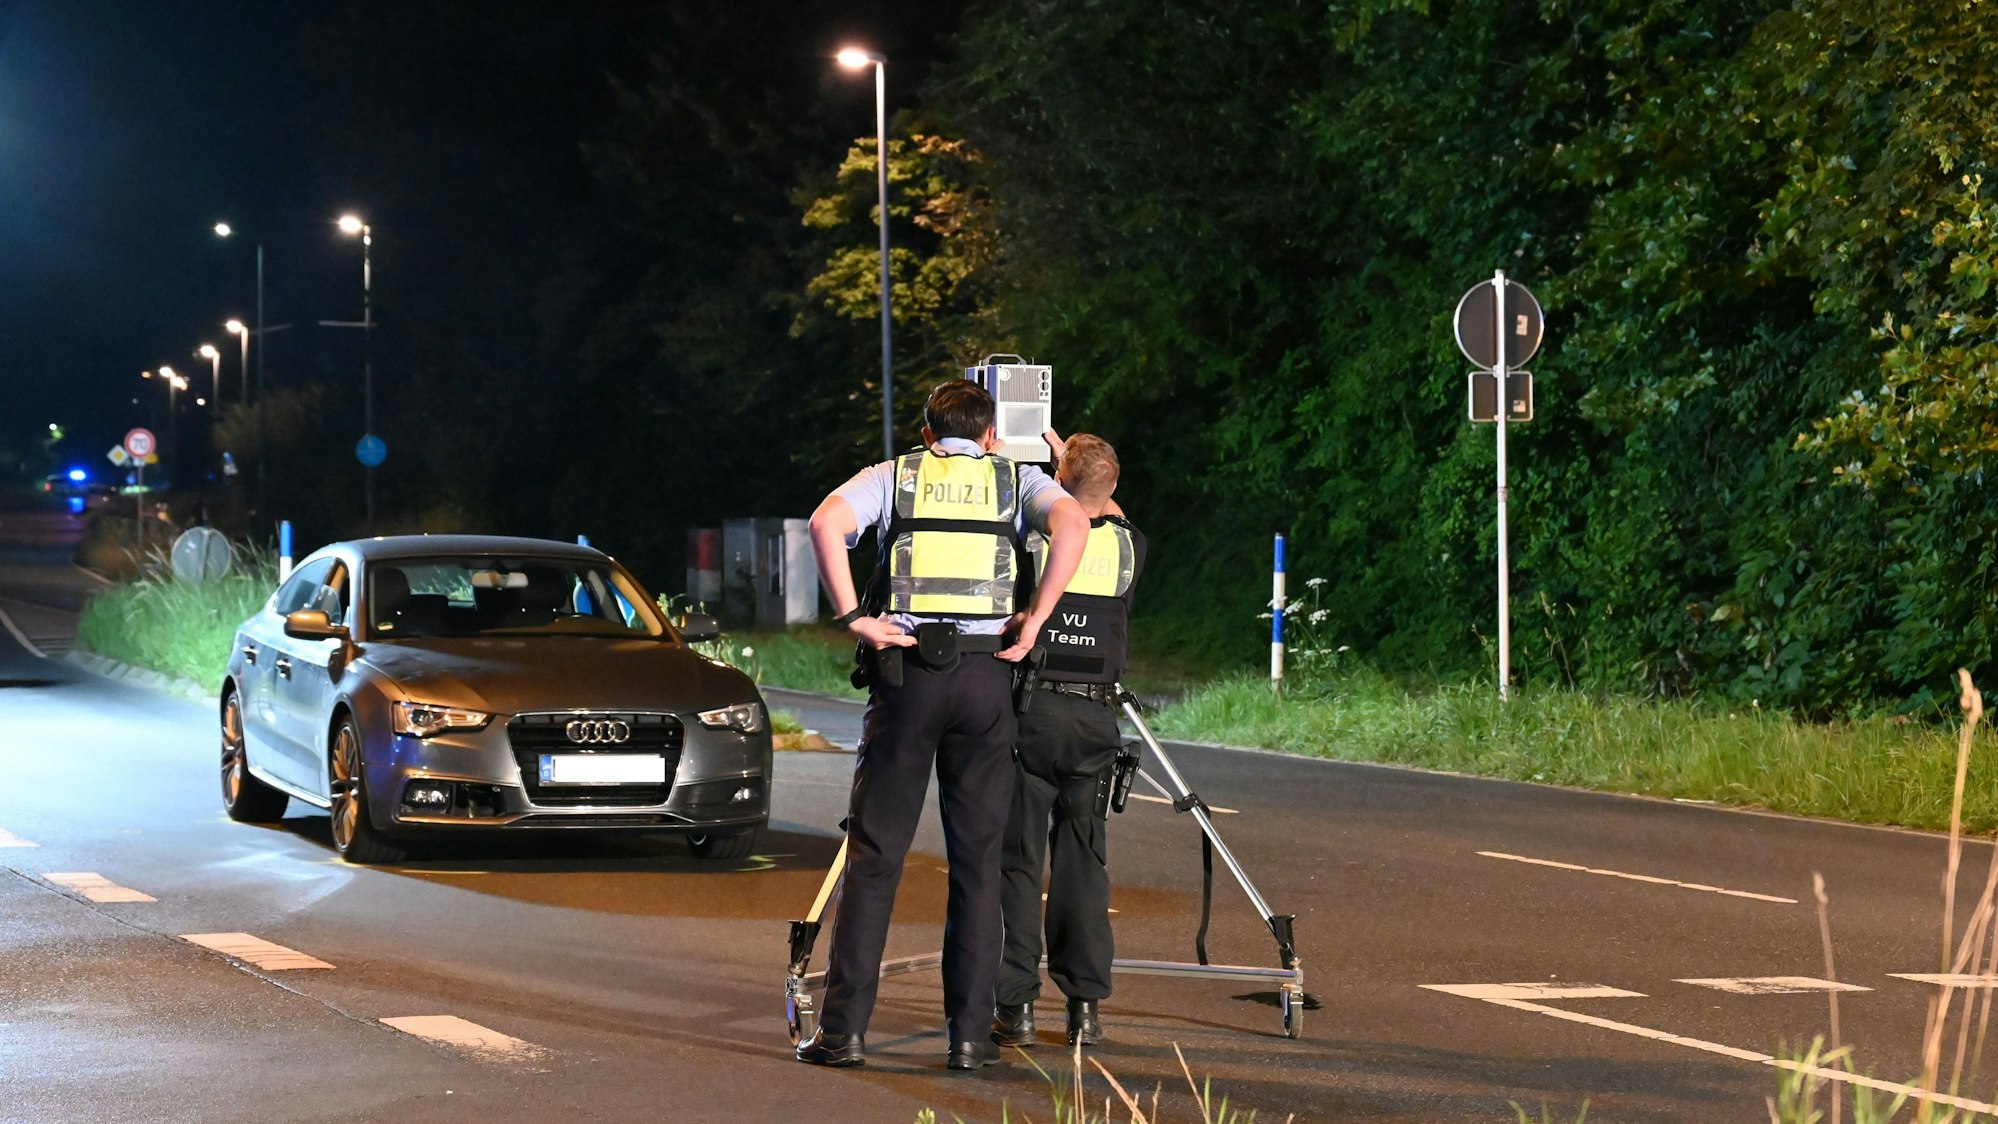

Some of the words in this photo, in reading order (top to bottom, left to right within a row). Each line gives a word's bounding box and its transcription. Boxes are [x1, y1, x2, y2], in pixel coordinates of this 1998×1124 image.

[133, 438, 148, 450] 70
[923, 482, 989, 505] POLIZEI
[1077, 555, 1112, 578] IZEI
[1062, 613, 1087, 627] VU
[1047, 629, 1096, 646] Team
